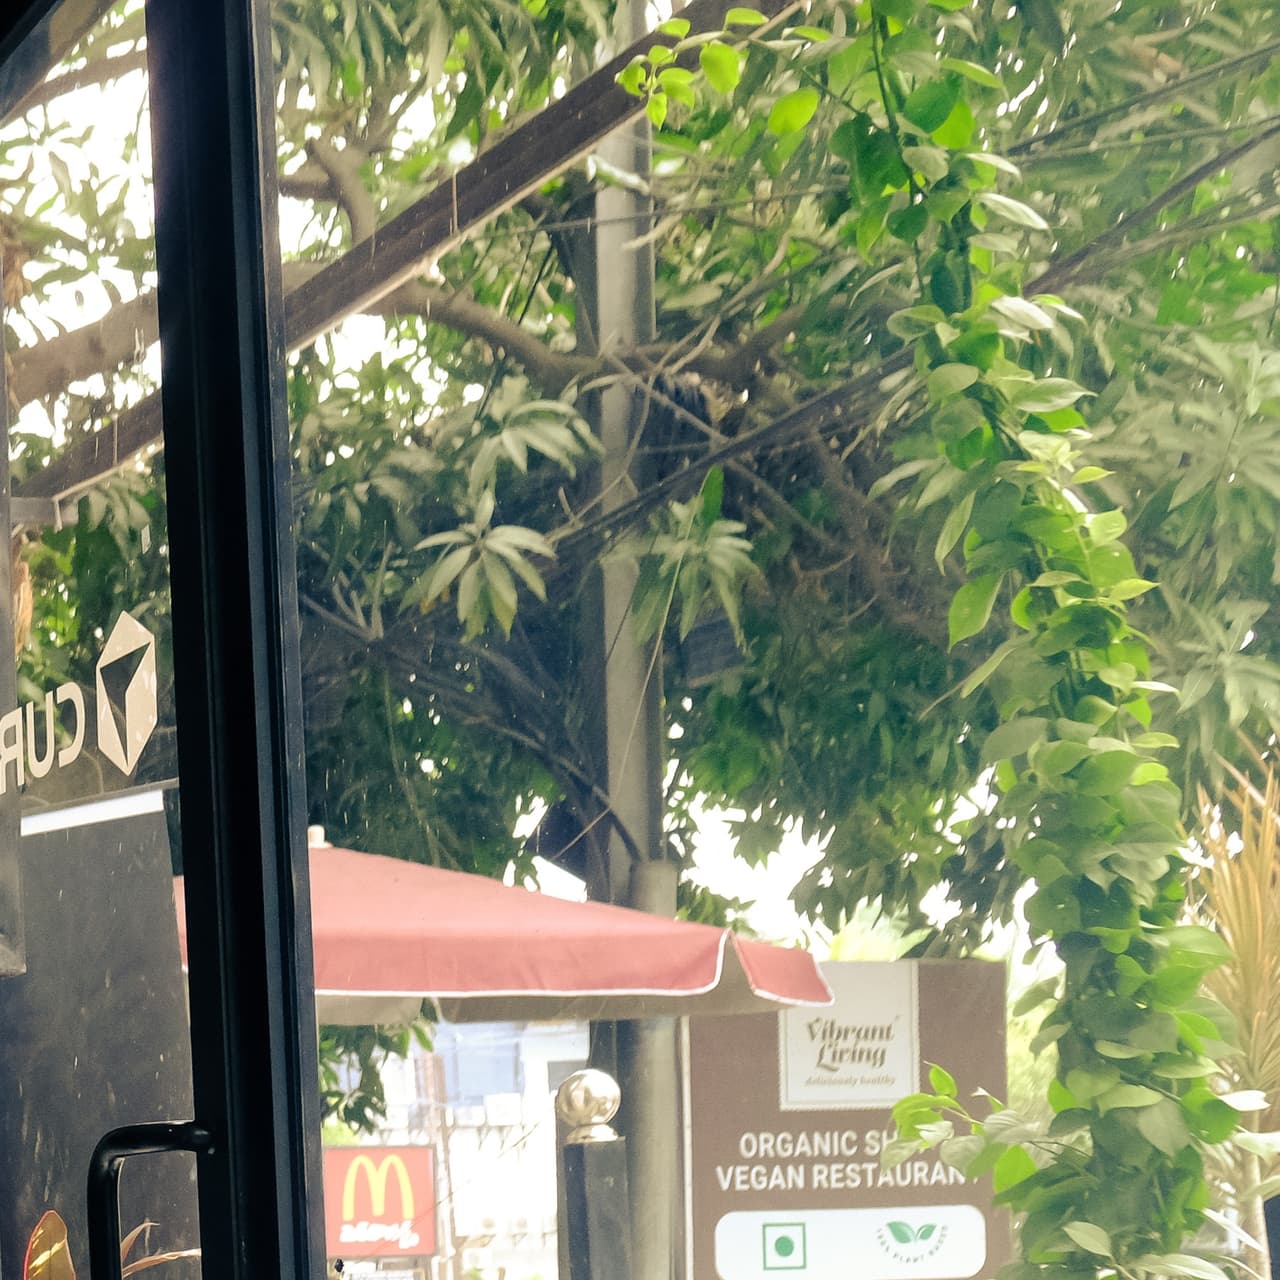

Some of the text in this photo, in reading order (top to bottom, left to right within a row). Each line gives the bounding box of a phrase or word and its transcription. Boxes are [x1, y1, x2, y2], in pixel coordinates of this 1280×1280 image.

[807, 1016, 895, 1043] Vibrant
[816, 1042, 888, 1072] Living
[740, 1131, 858, 1159] ORGANIC
[715, 1160, 979, 1191] VEGAN RESTAURAN
